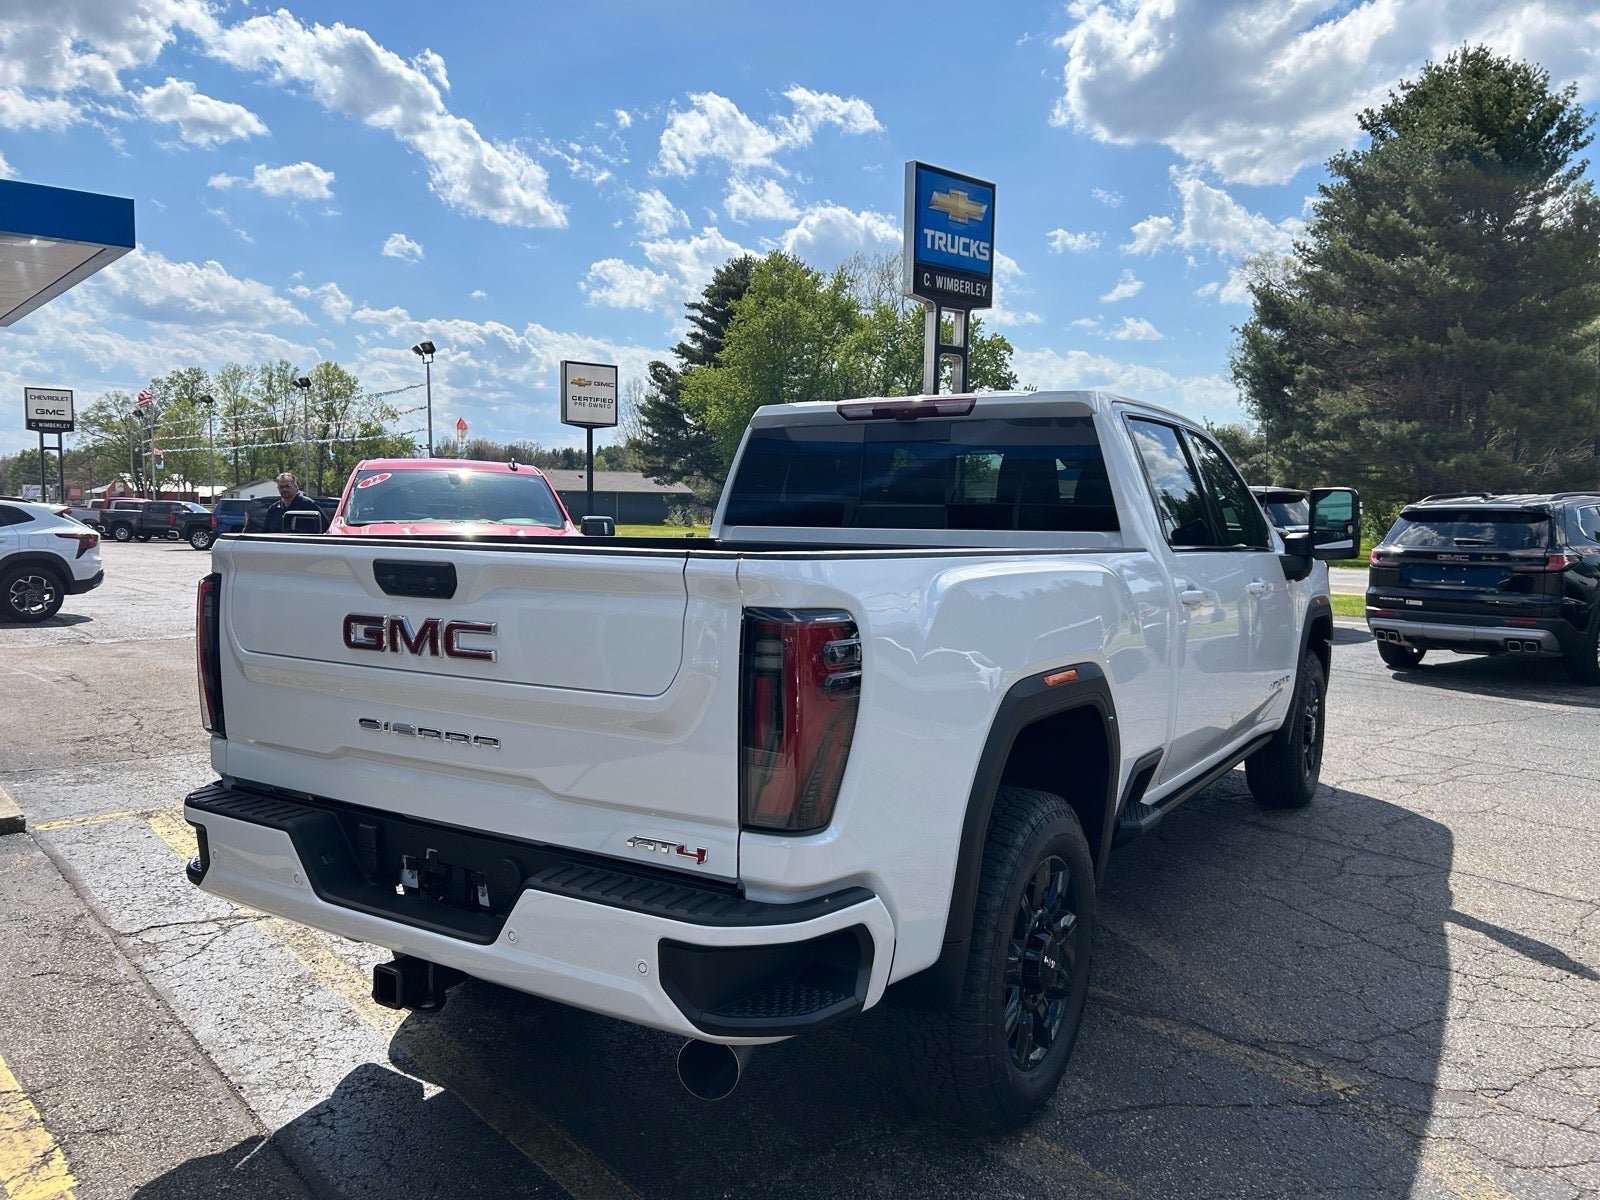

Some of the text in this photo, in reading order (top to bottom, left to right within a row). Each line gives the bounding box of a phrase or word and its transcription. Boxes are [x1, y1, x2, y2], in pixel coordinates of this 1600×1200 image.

[923, 228, 990, 261] TRUCKS
[923, 272, 988, 297] C. WIMBERLEY
[29, 394, 69, 402] CHEVROLET
[571, 395, 614, 404] CERTIFIED
[35, 408, 65, 416] GMC
[1437, 554, 1469, 562] GMC
[342, 612, 498, 664] GMC
[358, 717, 502, 750] SIERRA
[626, 834, 709, 865] AT4
